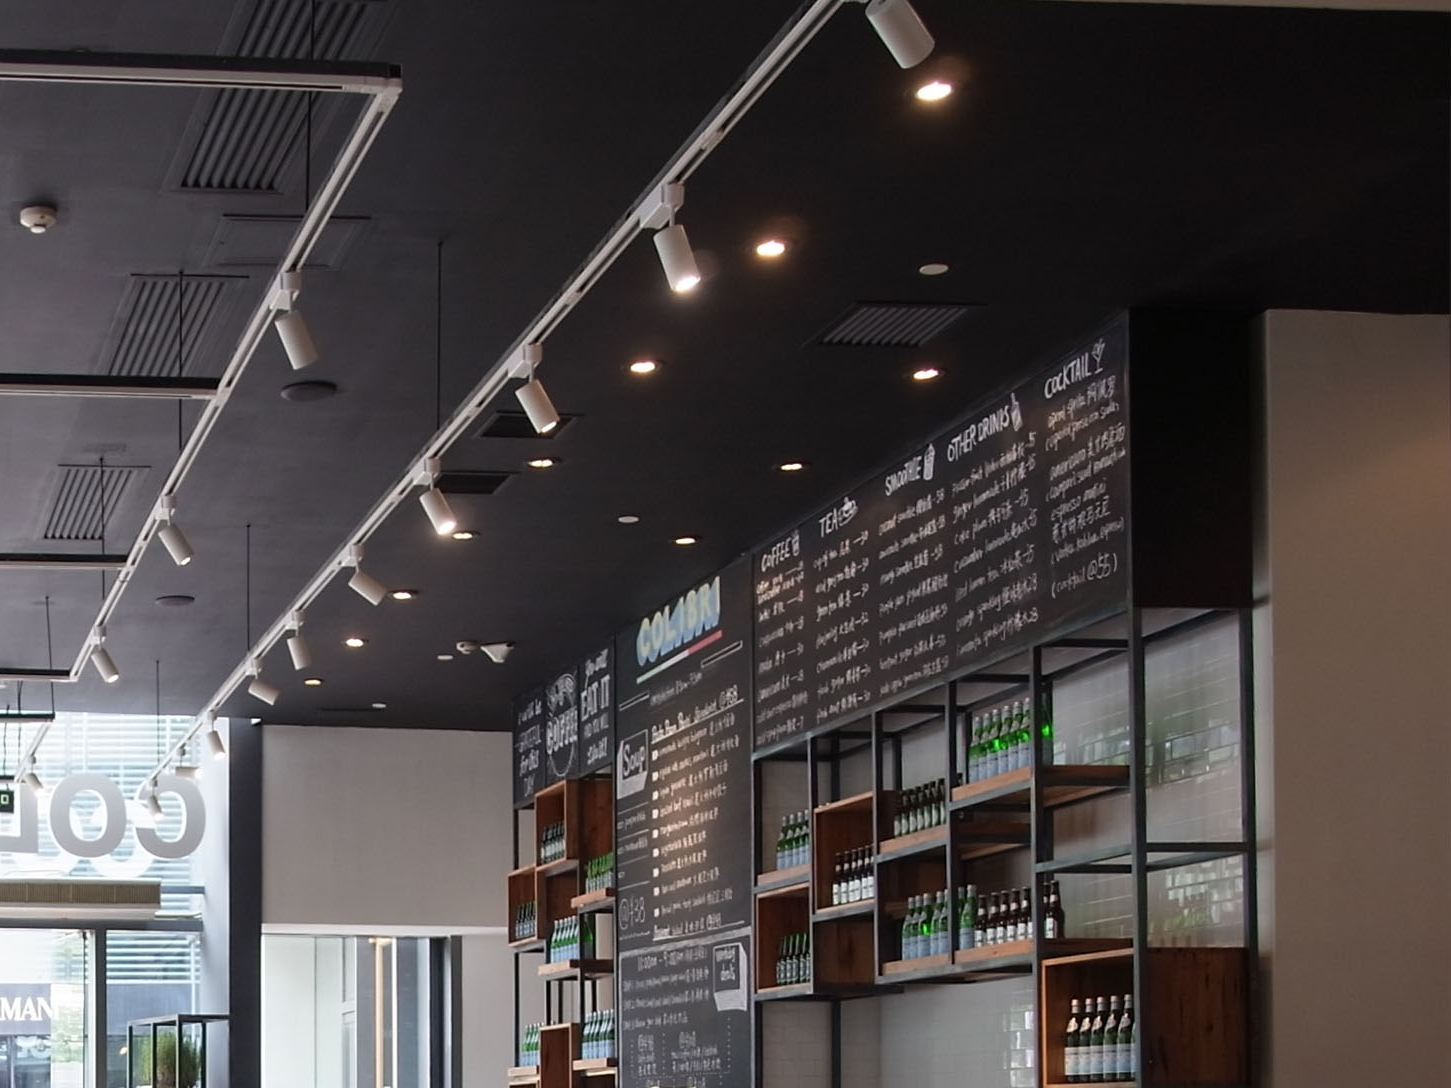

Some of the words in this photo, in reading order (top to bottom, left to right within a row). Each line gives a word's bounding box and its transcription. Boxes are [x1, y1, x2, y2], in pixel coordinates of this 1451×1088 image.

[1044, 352, 1092, 399] COCKTAIL
[947, 424, 977, 462] OTHER
[978, 405, 1010, 442] DRINKS
[818, 507, 839, 538] TEA
[761, 537, 792, 572] COFFEE
[636, 575, 721, 667] COLIBRI
[546, 705, 578, 755] COFFEE
[623, 743, 646, 777] Soup
